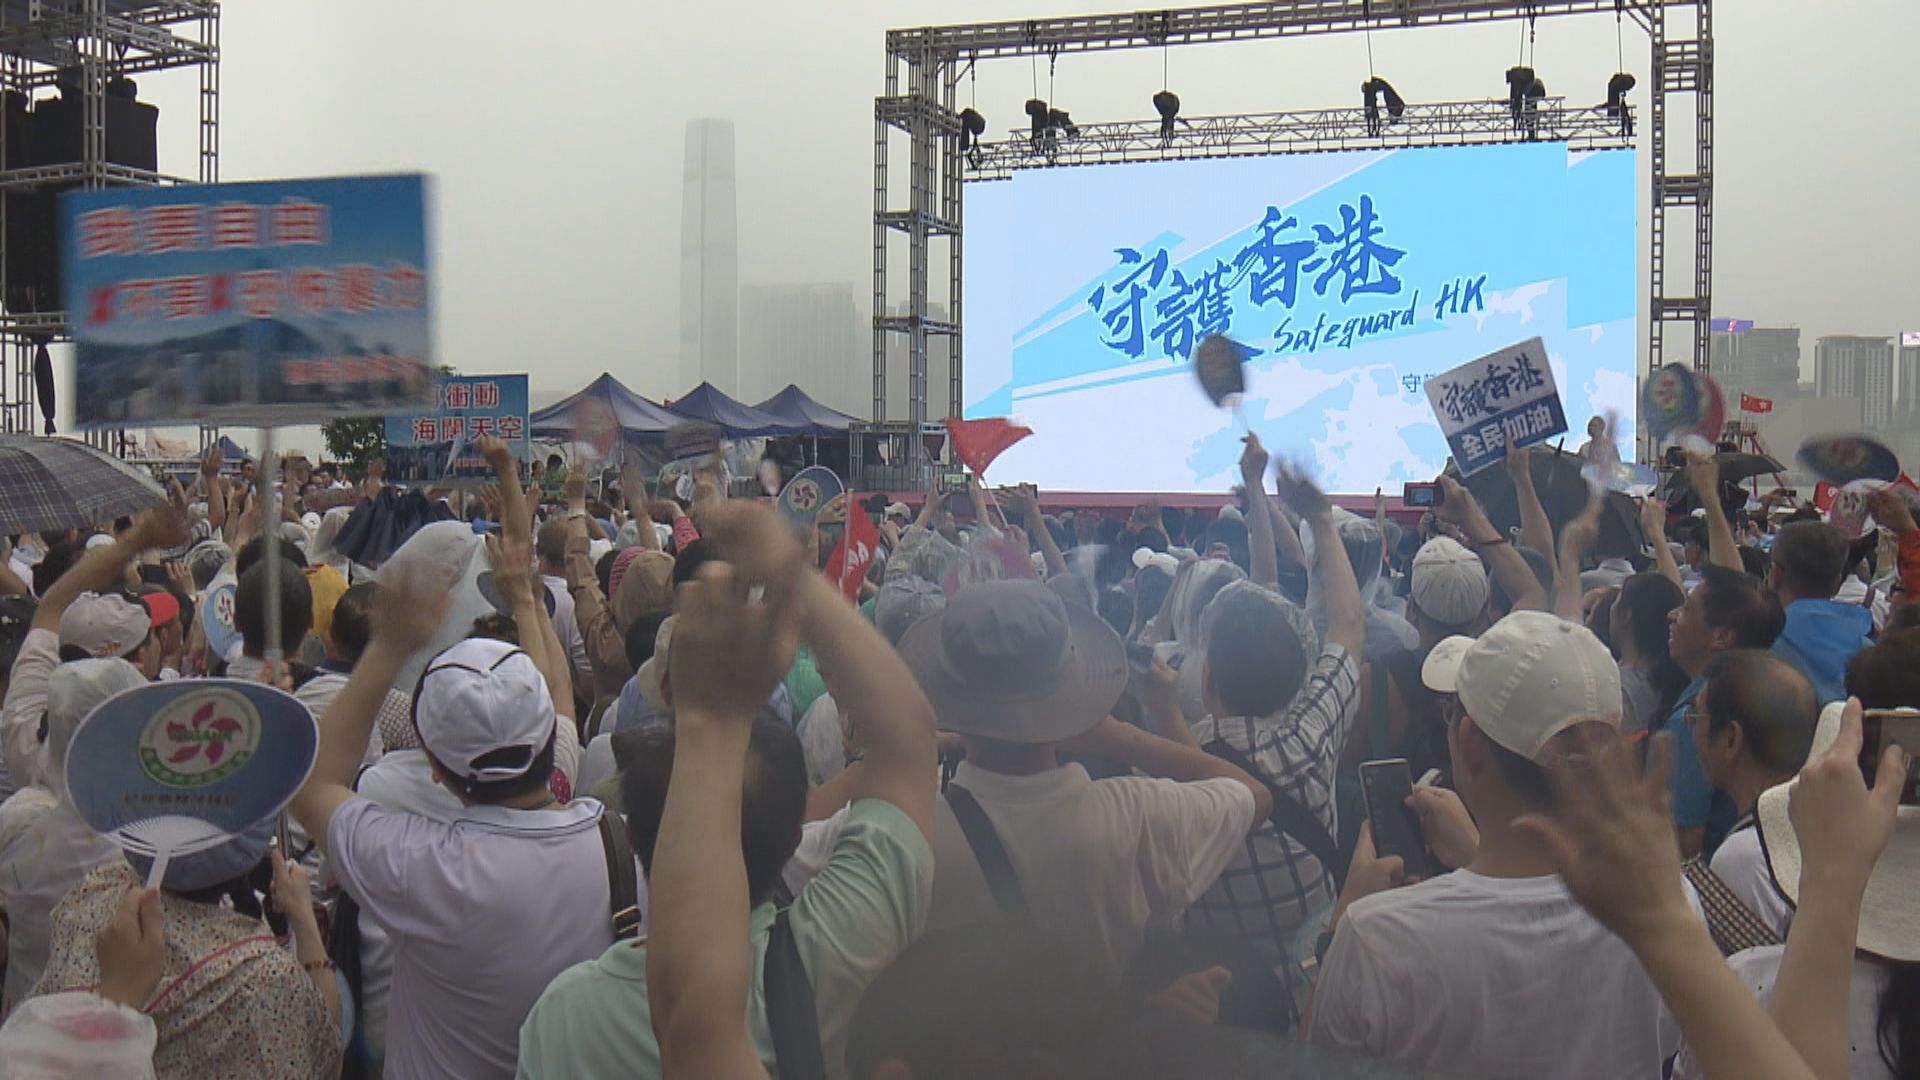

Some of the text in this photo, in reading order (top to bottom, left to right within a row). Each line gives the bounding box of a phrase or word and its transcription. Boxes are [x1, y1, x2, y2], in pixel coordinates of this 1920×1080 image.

[1089, 194, 1408, 362] 守護香港
[1273, 274, 1487, 353] Safeguard HK
[1402, 373, 1434, 394] 守
[1439, 352, 1545, 423] 守護香港
[413, 416, 523, 442] 海闊天空
[1461, 404, 1553, 461] 全民加油
